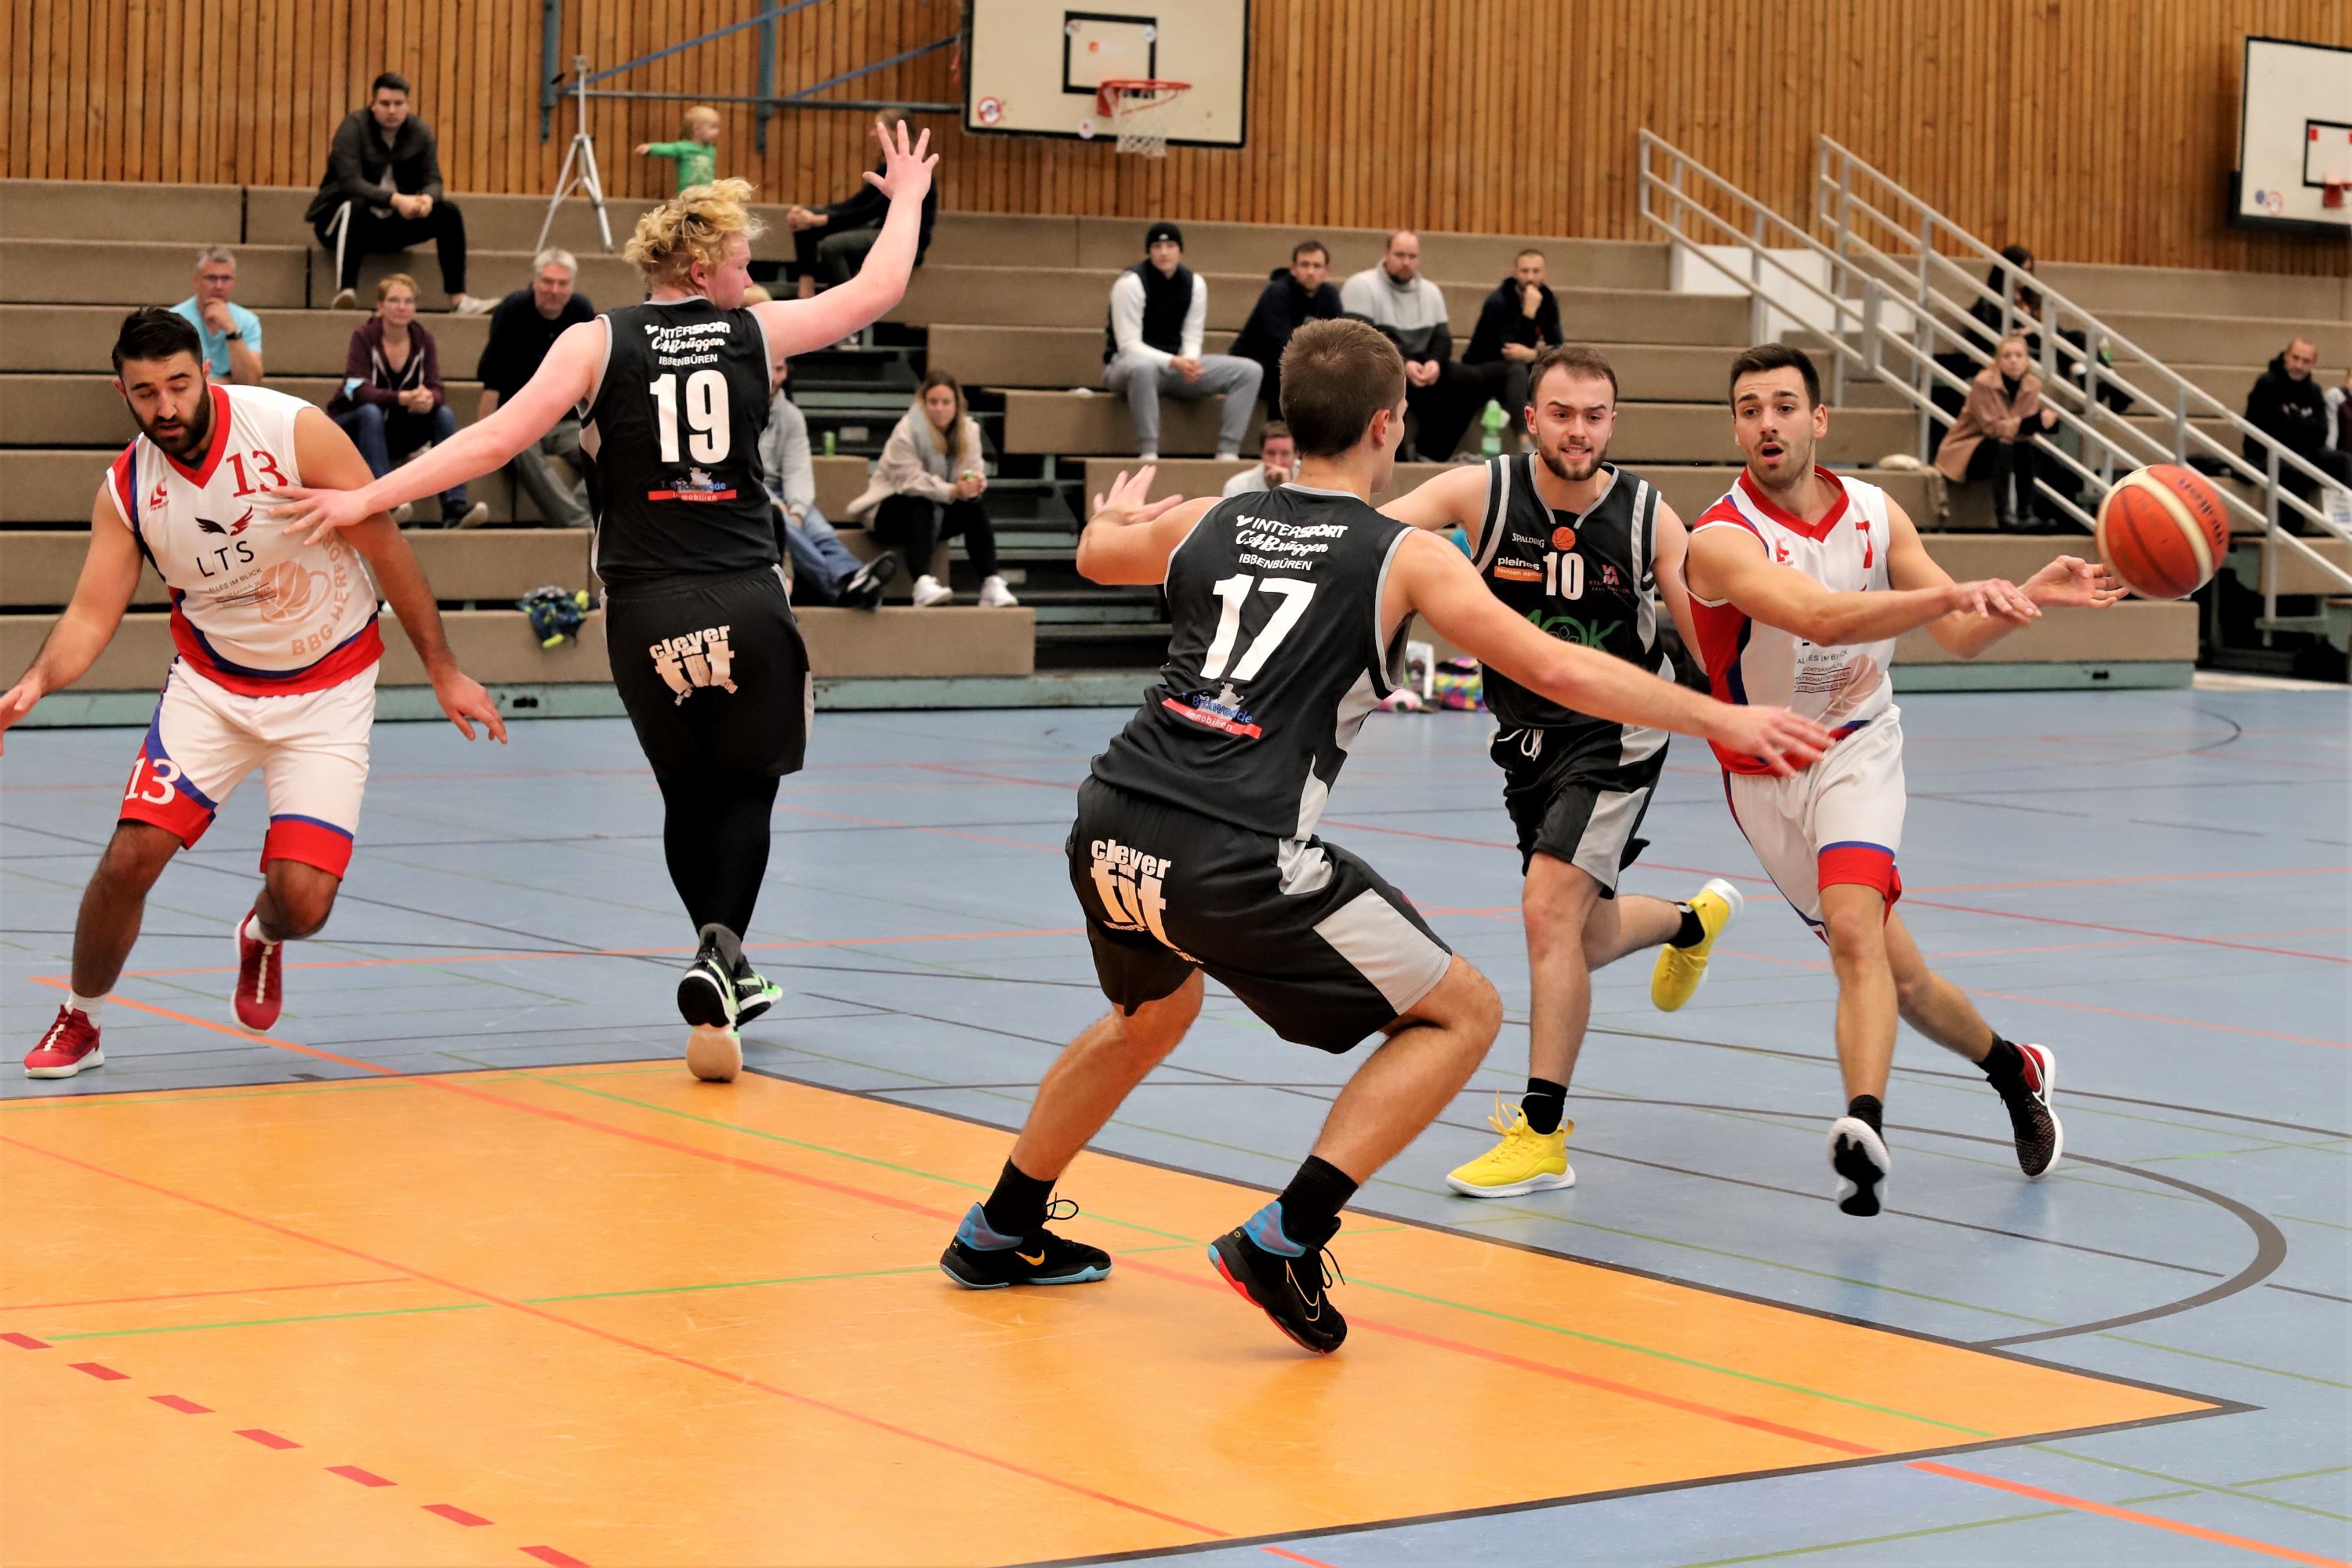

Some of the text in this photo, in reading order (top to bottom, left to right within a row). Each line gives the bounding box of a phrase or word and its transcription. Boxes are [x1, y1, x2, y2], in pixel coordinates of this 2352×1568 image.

[660, 321, 731, 339] NTERSPORT
[659, 354, 718, 366] IBBENBÜREN
[649, 369, 731, 464] 19
[226, 451, 289, 497] 13
[673, 492, 717, 501] Imobilien
[1251, 518, 1348, 539] INTERSPORT
[1512, 533, 1544, 548] SPALDING
[1855, 521, 1873, 568] 7
[196, 541, 254, 577] LTS
[1239, 554, 1313, 571] IBBENBÜREN
[1497, 557, 1540, 570] pleines
[240, 568, 262, 582] BLICK
[1543, 552, 1584, 601] 10
[291, 623, 333, 656] BBG
[1200, 573, 1317, 681] 17
[649, 625, 731, 659] clever
[1798, 655, 1819, 664] ALES
[1185, 710, 1233, 731] Immobilien
[124, 757, 181, 805] 13
[1091, 838, 1172, 880] clever
